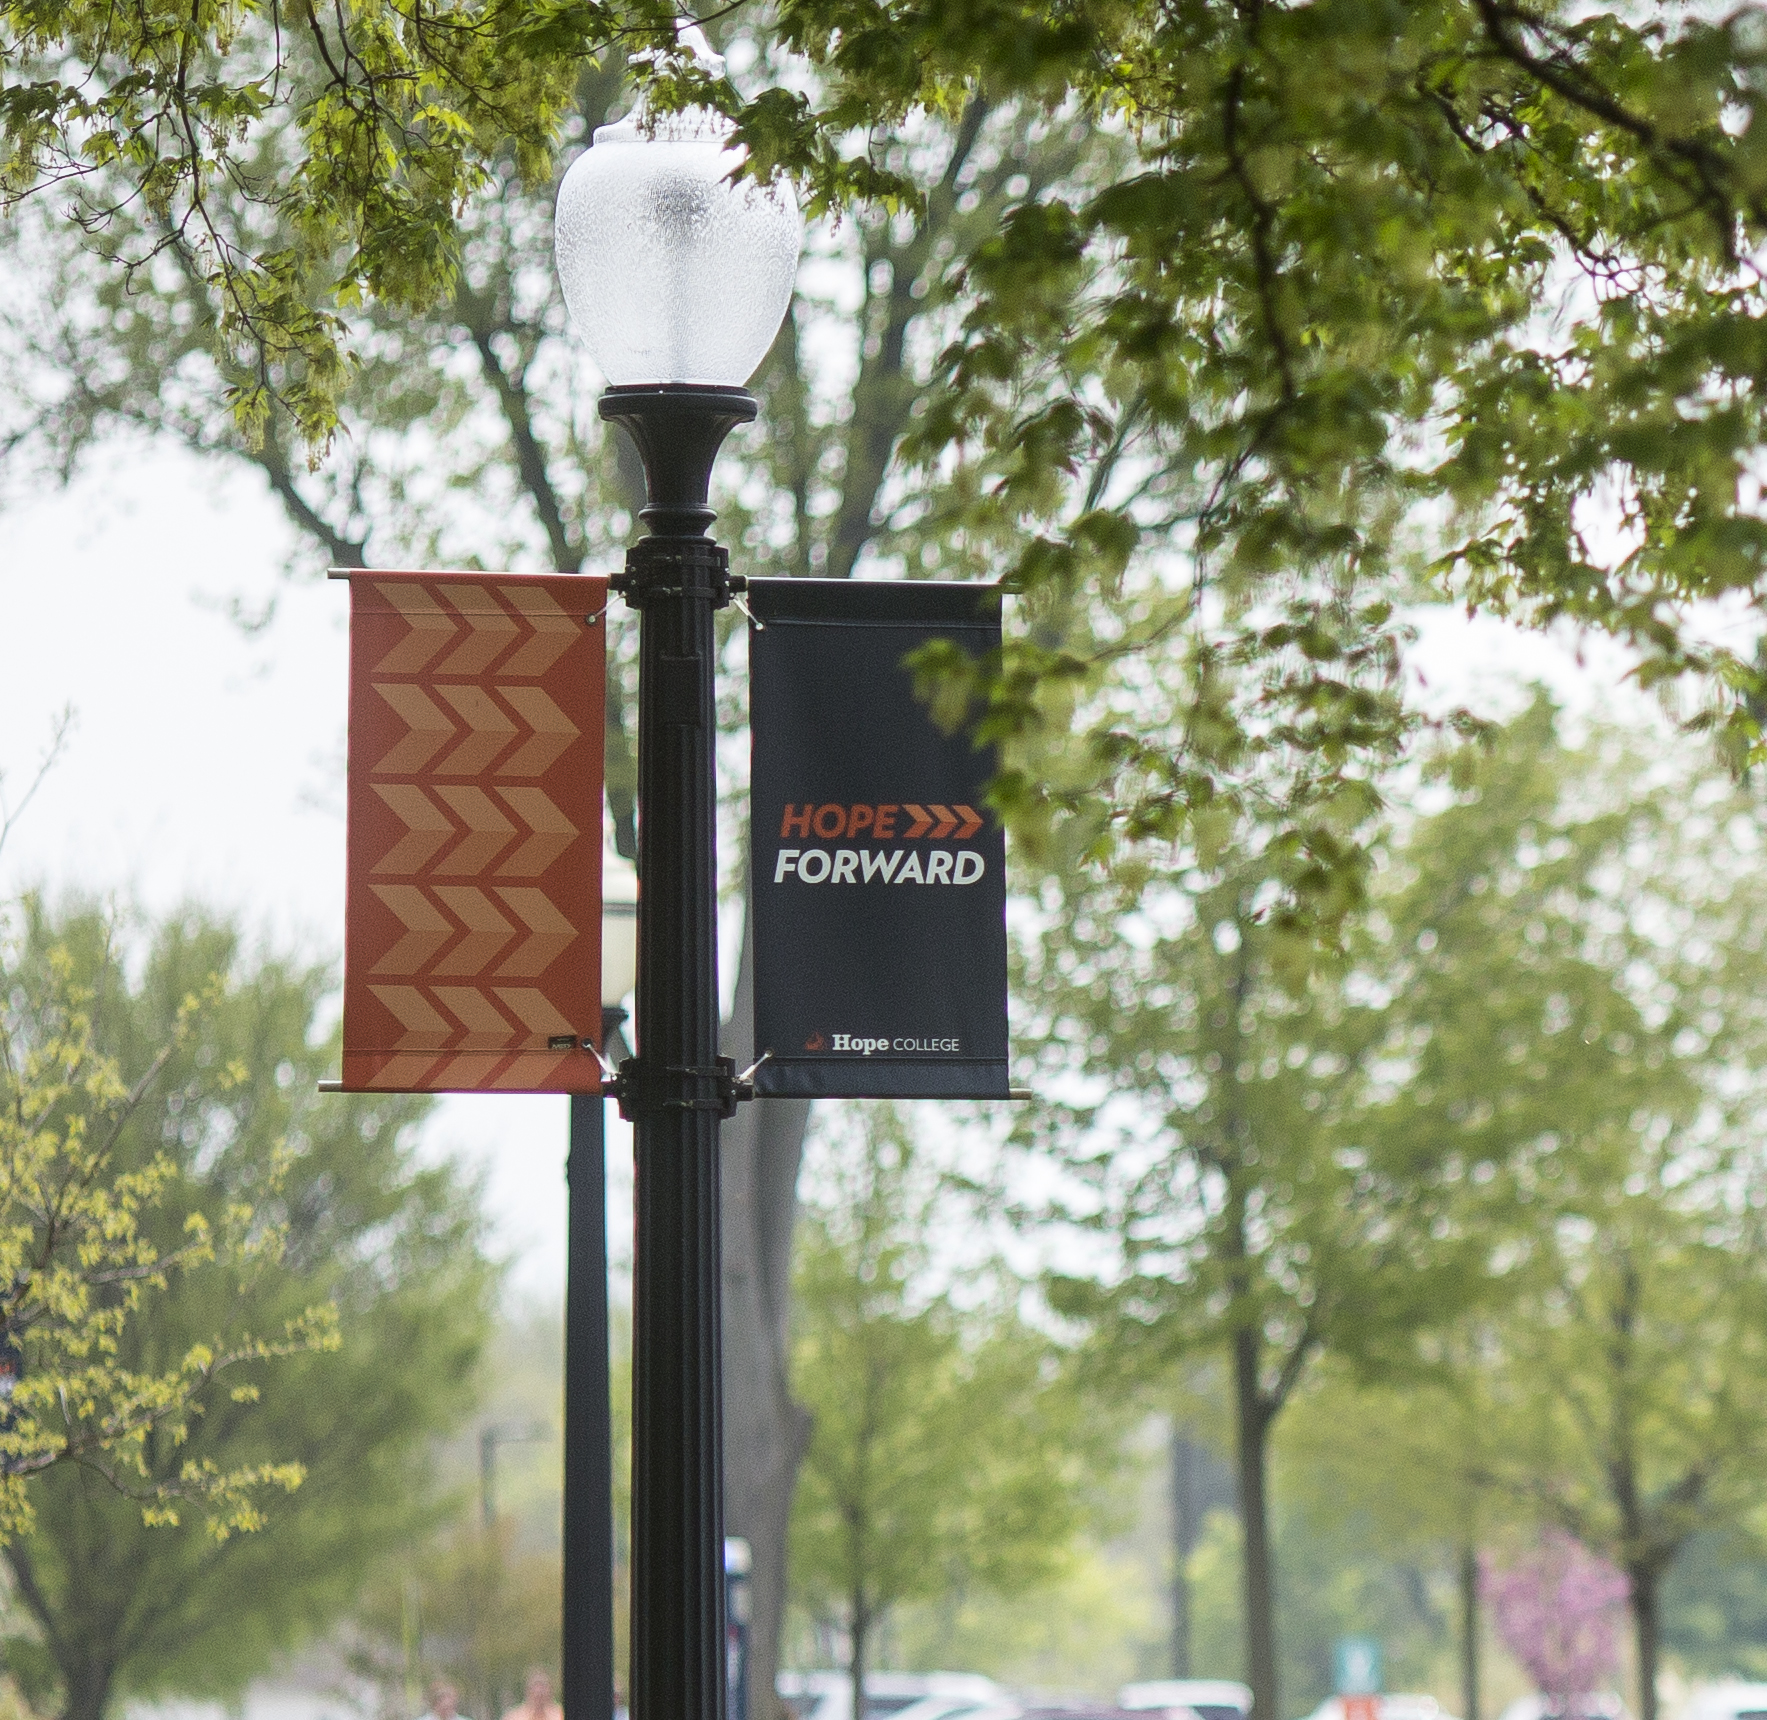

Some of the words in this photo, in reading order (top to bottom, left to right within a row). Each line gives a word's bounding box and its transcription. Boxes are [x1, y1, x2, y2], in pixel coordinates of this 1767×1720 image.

[779, 803, 899, 839] HOPE
[774, 849, 985, 885] FORWARD
[832, 1033, 889, 1055] Hope
[893, 1037, 960, 1052] COLLEGE
